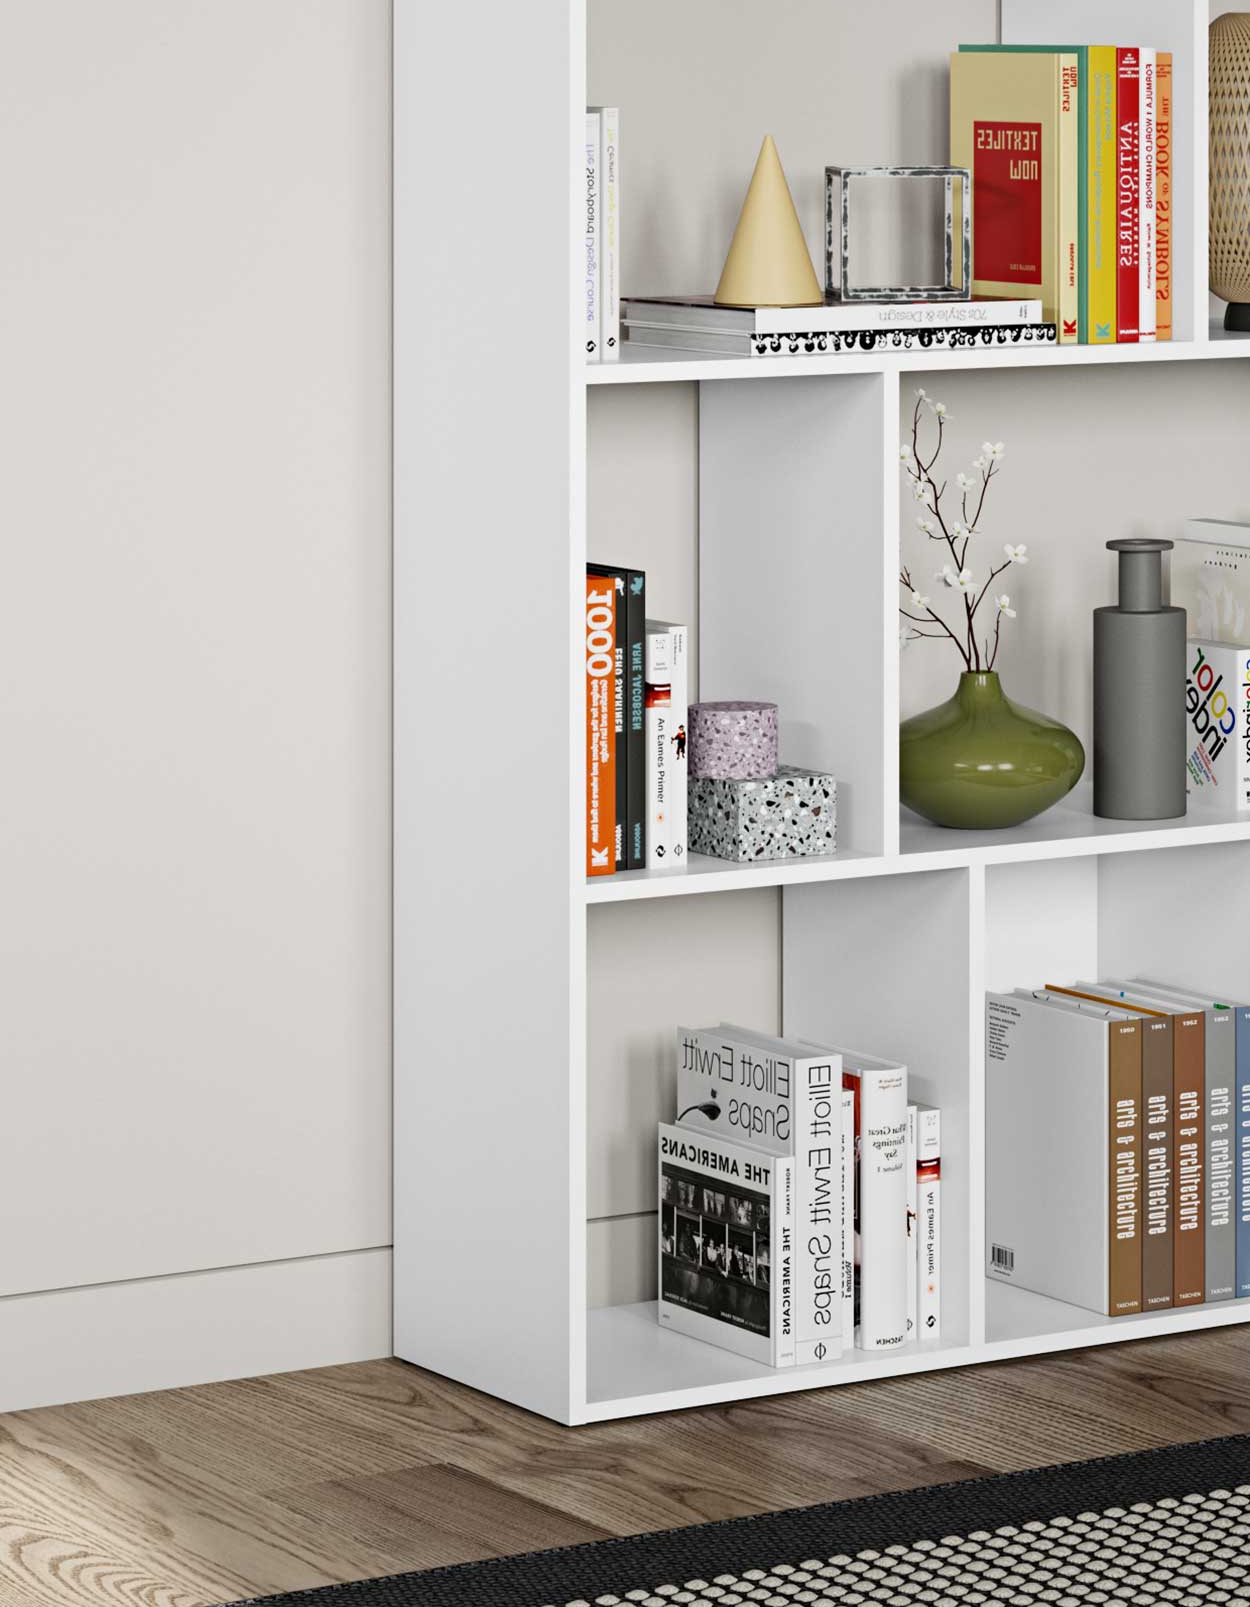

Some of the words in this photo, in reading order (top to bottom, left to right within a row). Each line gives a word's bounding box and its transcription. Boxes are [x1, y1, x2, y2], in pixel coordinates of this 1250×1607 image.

[878, 310, 922, 323] Design
[924, 310, 935, 321] &
[937, 308, 967, 322] Style
[657, 718, 665, 731] An
[657, 735, 665, 768] Eames
[657, 771, 665, 804] Primer
[1117, 1099, 1138, 1128] arts
[1148, 1095, 1169, 1124] arts
[1180, 1091, 1200, 1120] arts
[1211, 1087, 1231, 1116] arts
[1117, 1151, 1139, 1240] architecture
[1148, 1147, 1171, 1235] architecture
[1180, 1143, 1202, 1231] architecture
[1211, 1138, 1233, 1226] architecture
